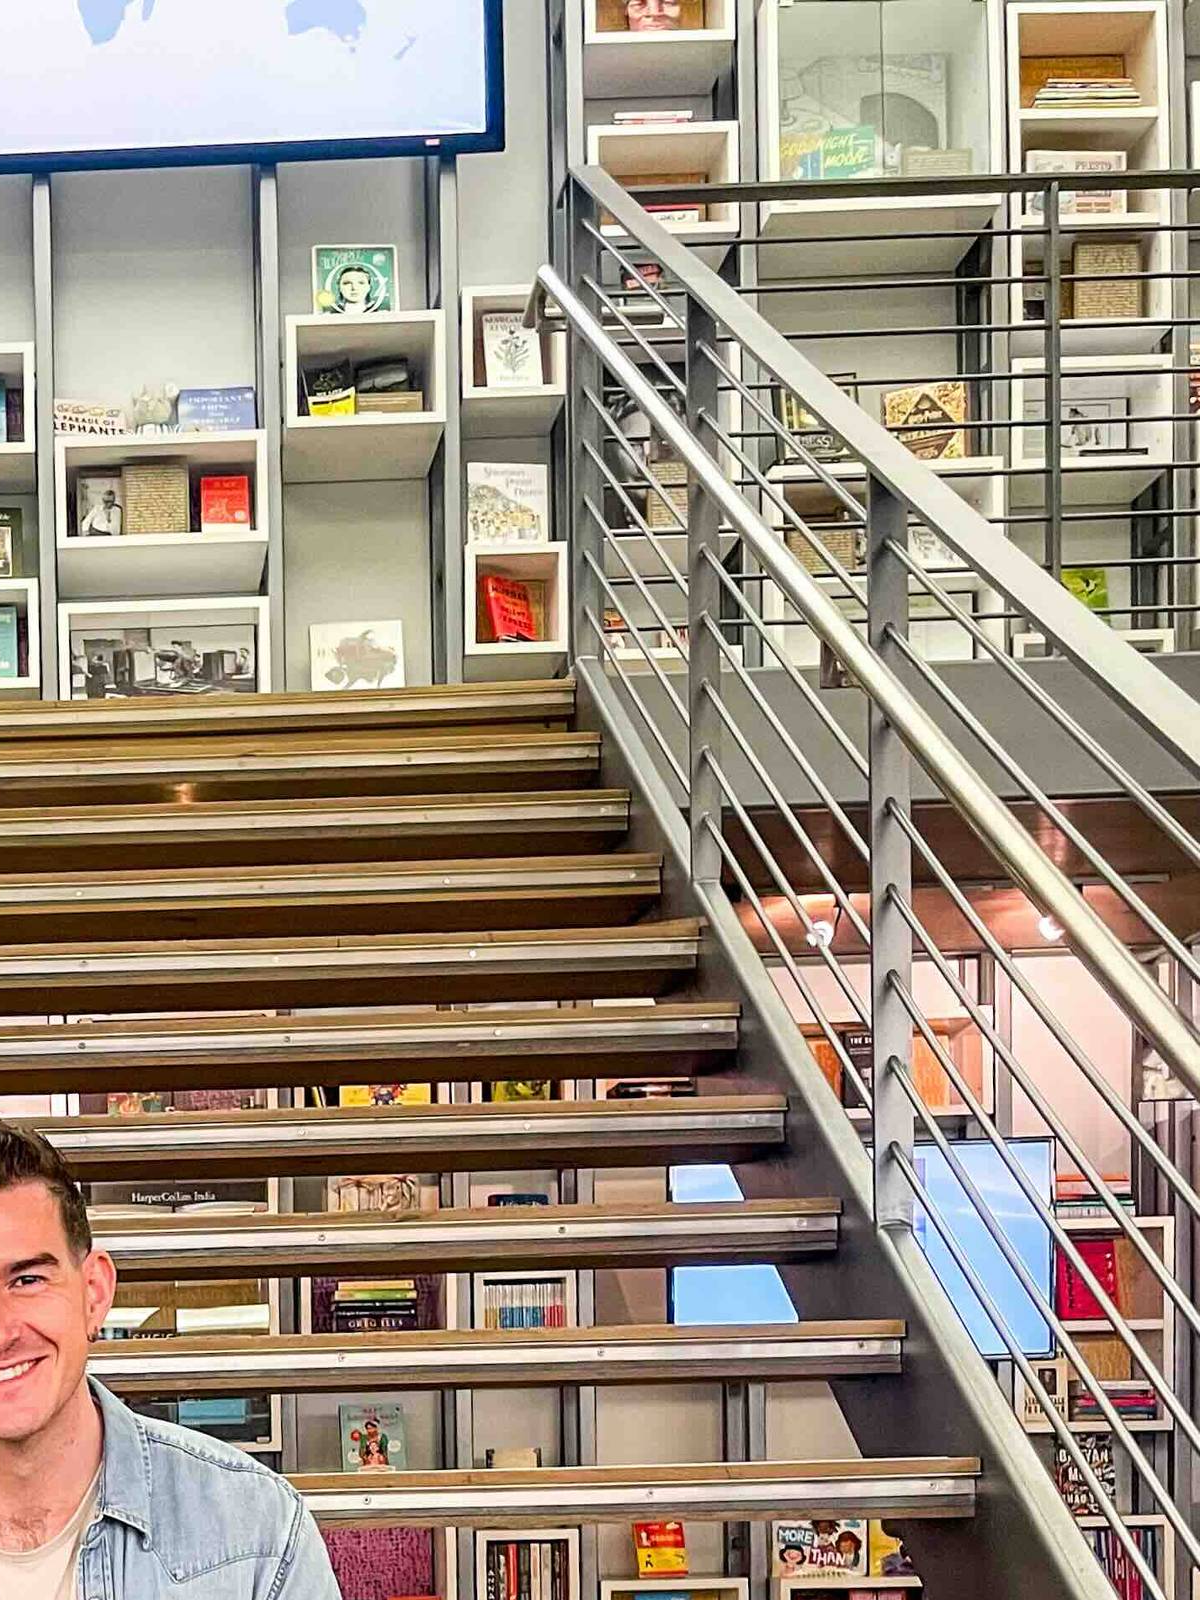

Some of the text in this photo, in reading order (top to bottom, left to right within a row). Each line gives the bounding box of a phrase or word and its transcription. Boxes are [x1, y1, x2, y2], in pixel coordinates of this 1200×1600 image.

[131, 1190, 216, 1204] HarperCollins India
[778, 1529, 813, 1544] MORE
[811, 1548, 847, 1566] THAN
